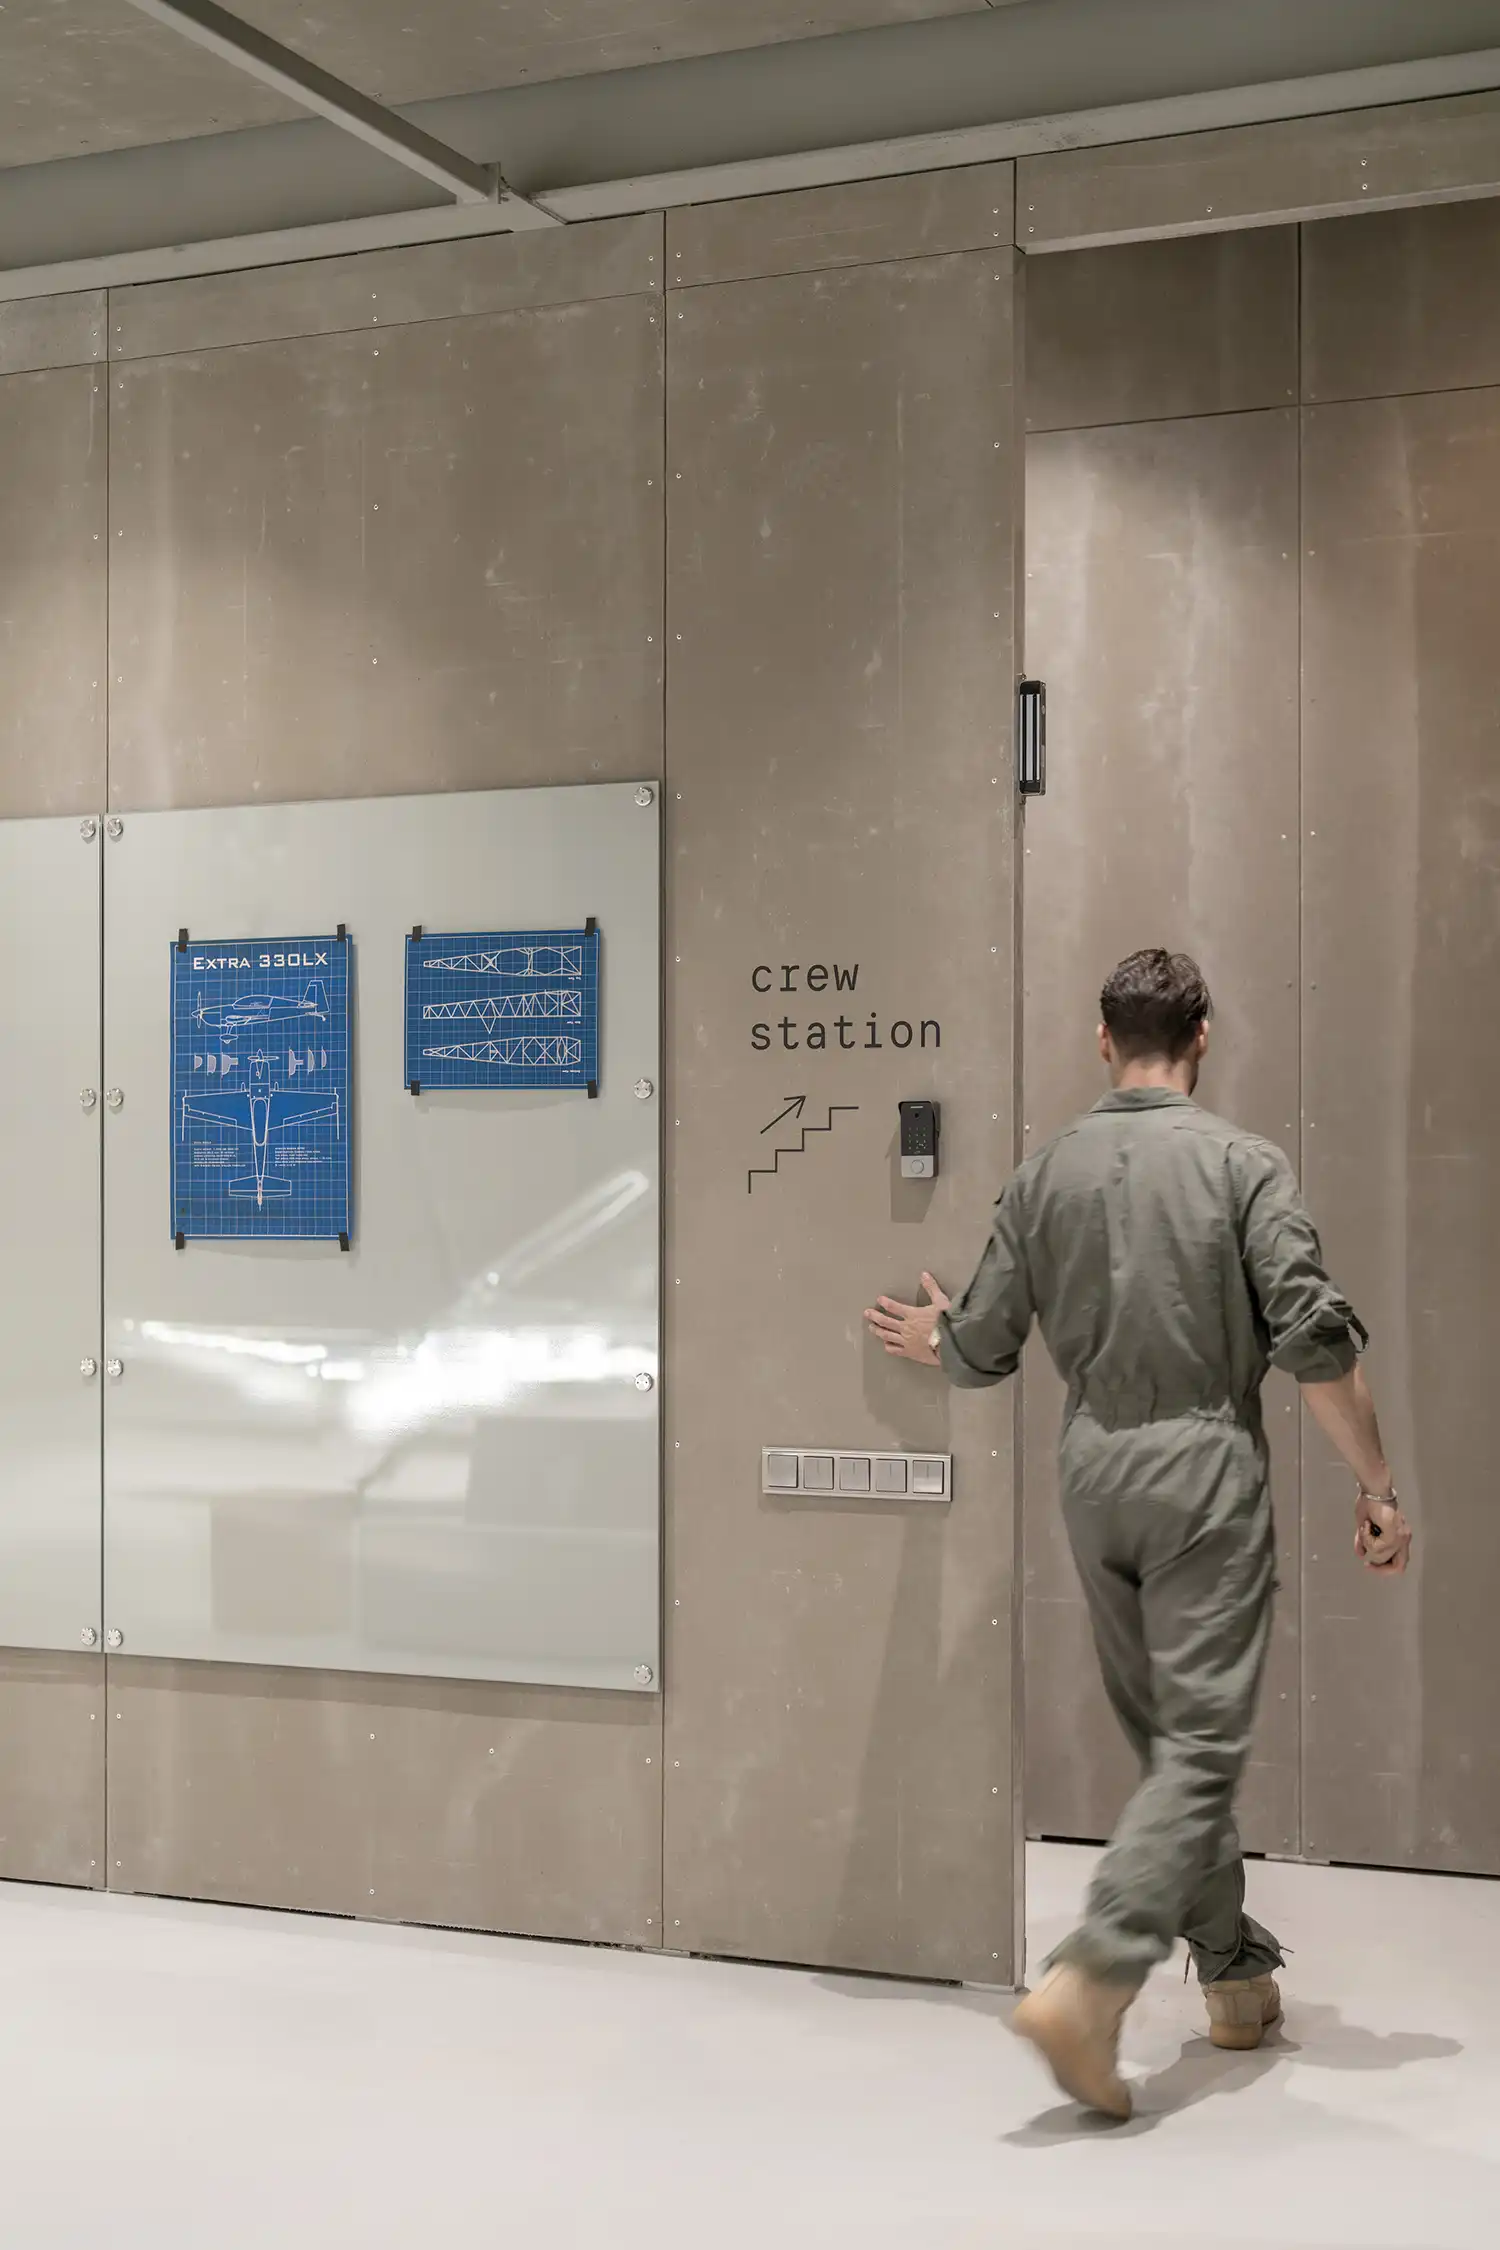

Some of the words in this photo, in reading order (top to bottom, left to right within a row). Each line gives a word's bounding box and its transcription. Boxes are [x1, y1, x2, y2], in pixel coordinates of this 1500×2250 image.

[259, 952, 328, 968] 330LX
[751, 963, 859, 993] crew
[751, 1011, 941, 1051] station
